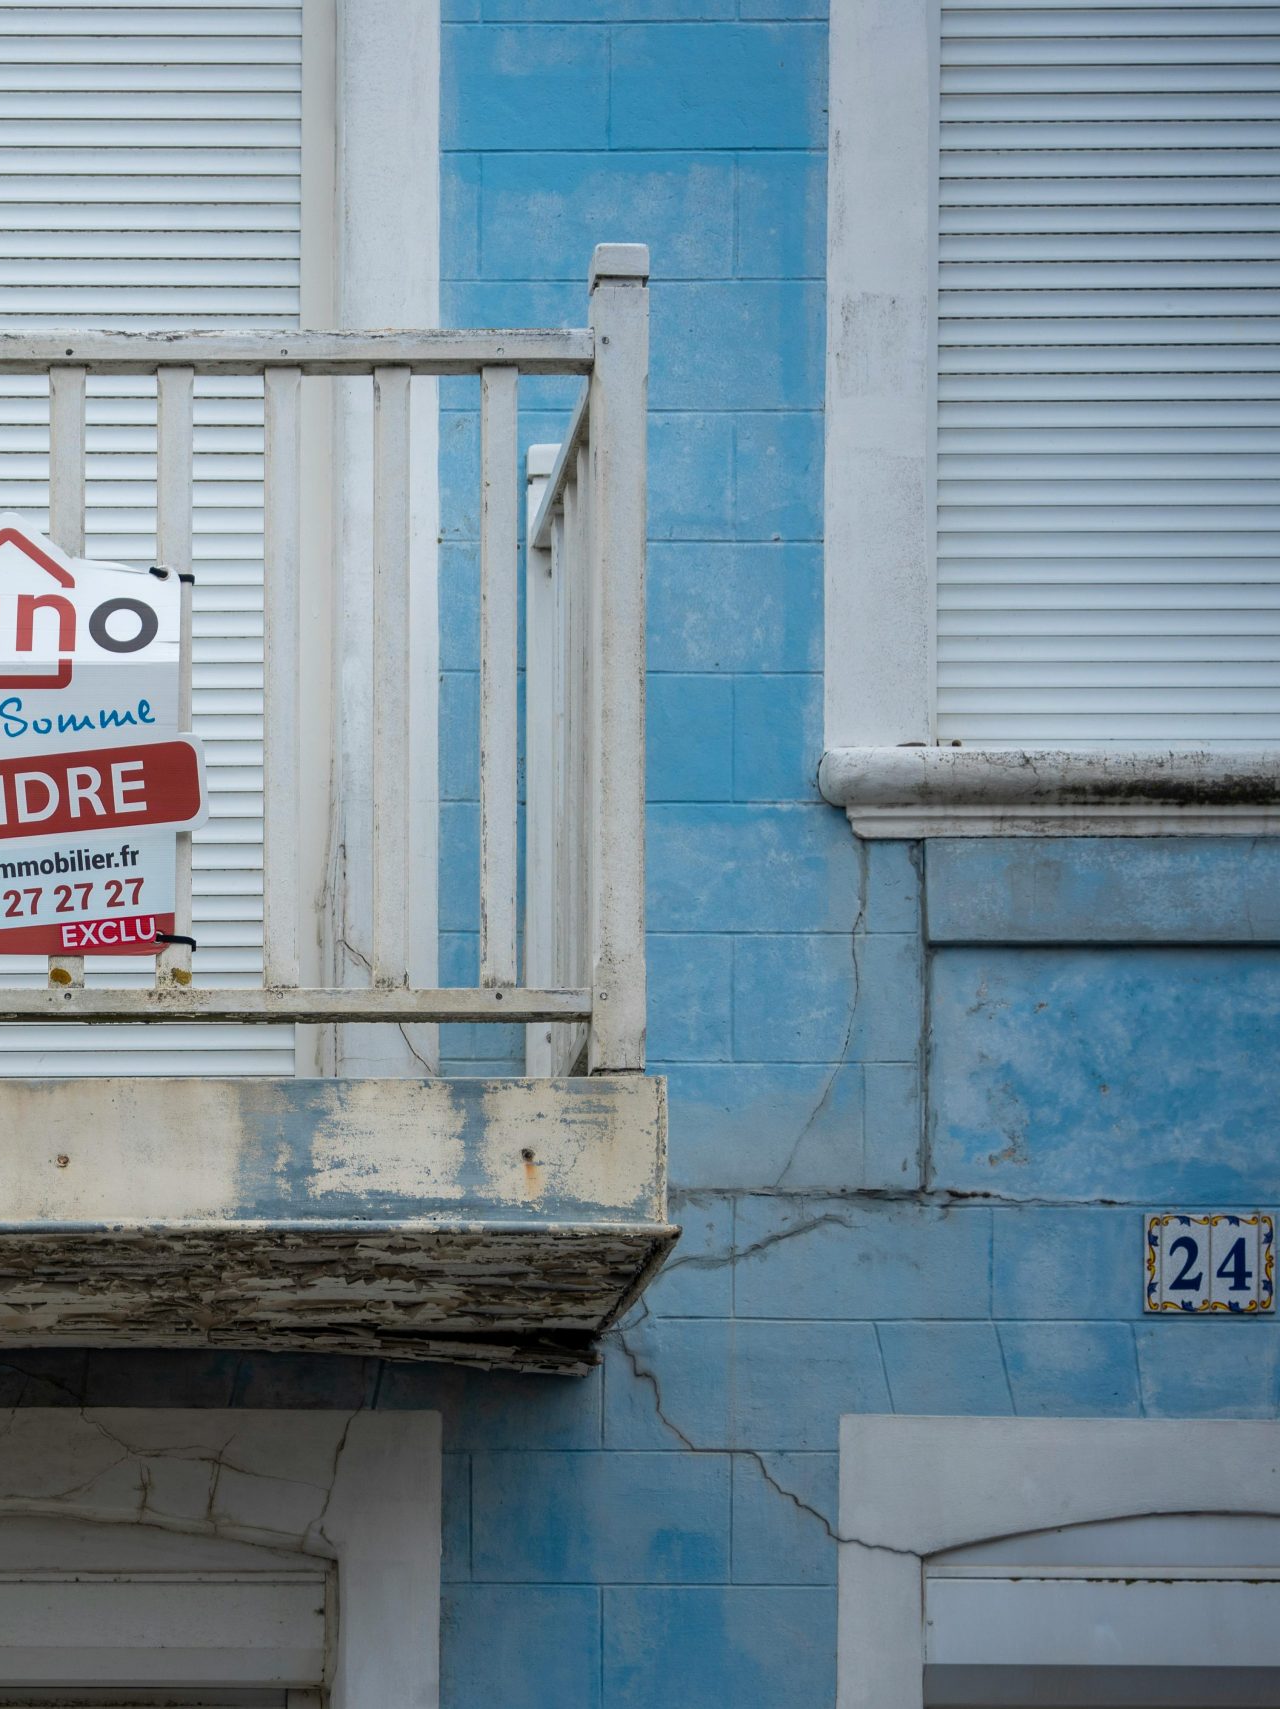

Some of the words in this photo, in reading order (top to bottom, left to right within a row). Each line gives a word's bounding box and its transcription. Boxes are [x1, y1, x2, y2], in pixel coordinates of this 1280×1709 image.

[5, 887, 44, 918] 27
[54, 883, 94, 912] 27
[104, 878, 145, 907] 27
[62, 917, 156, 948] EXCLU
[1169, 1236, 1252, 1291] 24
